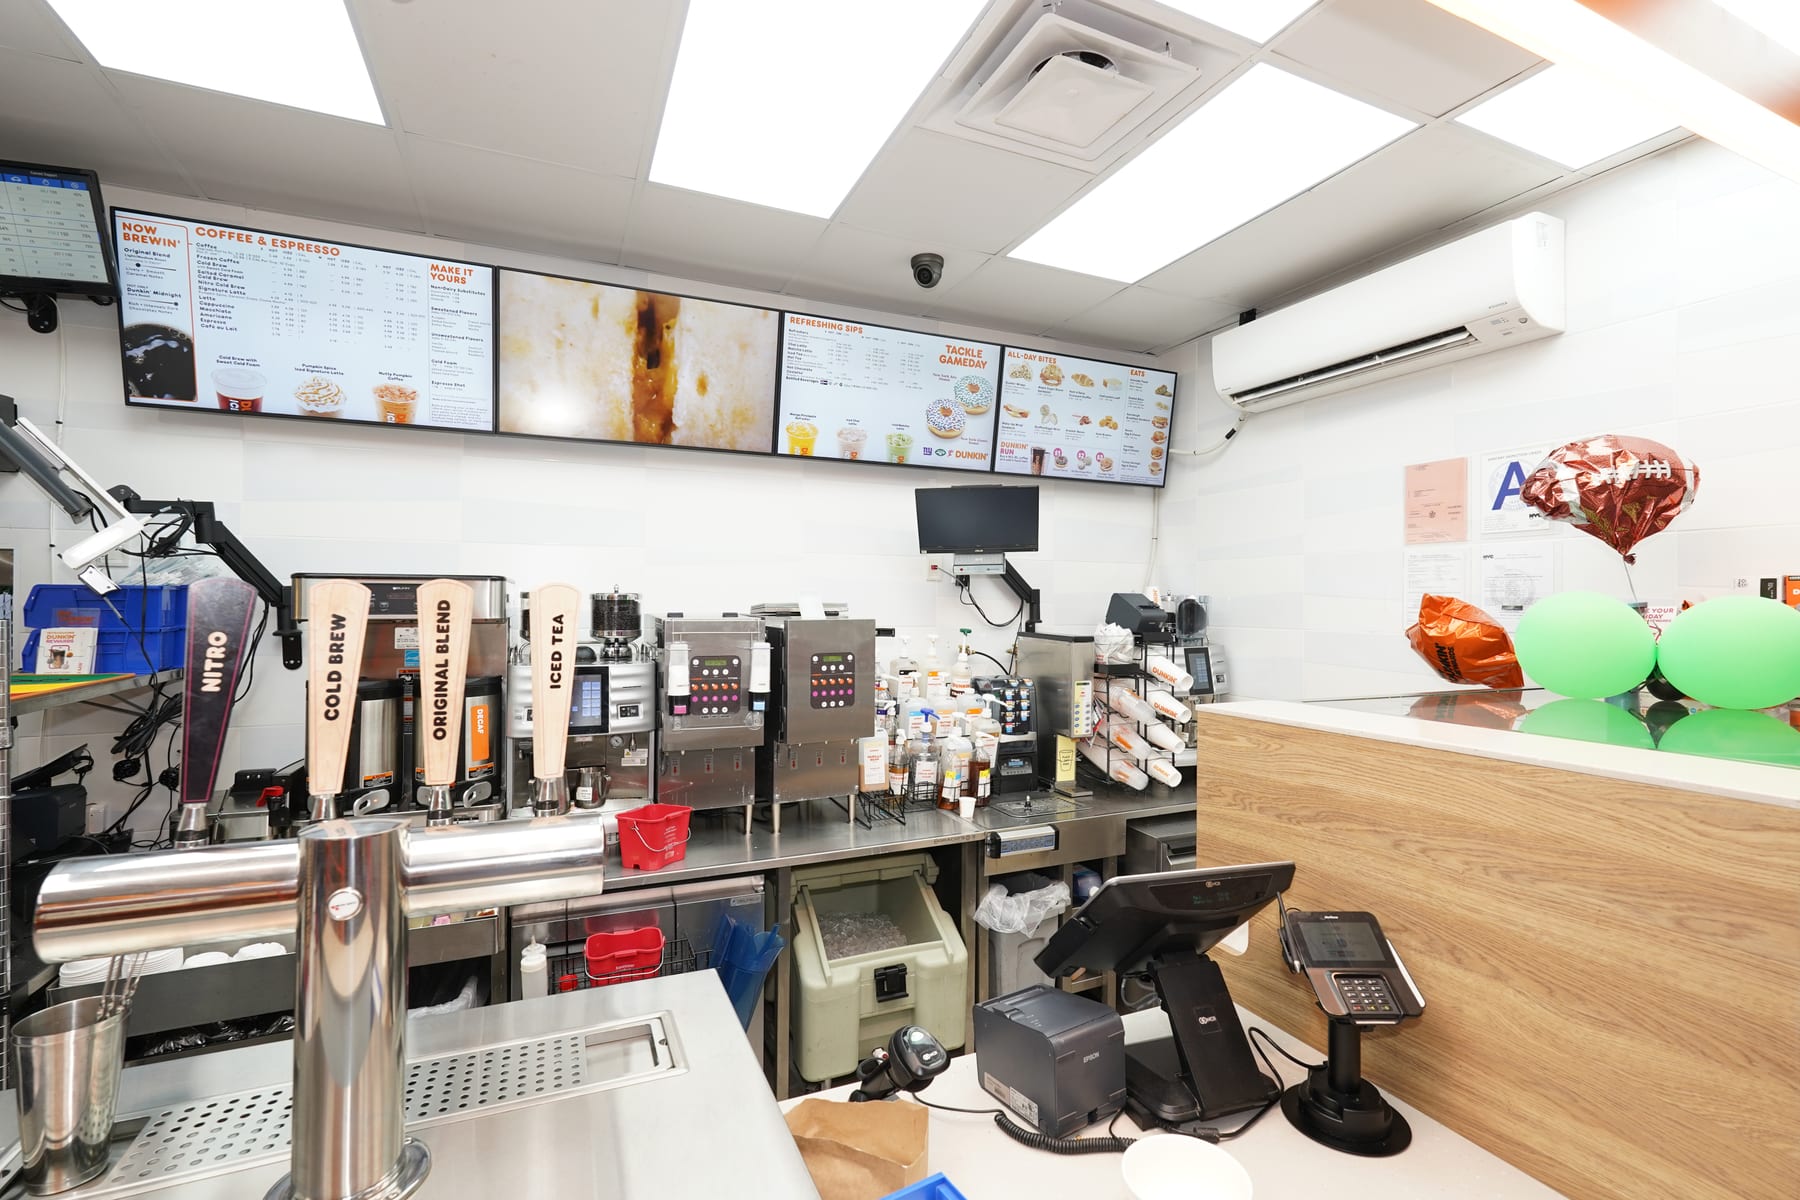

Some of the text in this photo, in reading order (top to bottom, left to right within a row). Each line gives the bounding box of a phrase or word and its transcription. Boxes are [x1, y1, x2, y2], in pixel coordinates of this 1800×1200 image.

[122, 222, 157, 235] NOW
[123, 232, 181, 248] BREWIN'
[195, 227, 340, 257] COFFEE & ESPRESSO
[430, 263, 474, 277] MAKE IT
[430, 272, 467, 284] YOURS
[789, 316, 864, 335] REFRESHING SIPS
[945, 344, 983, 359] TACKLE
[1007, 351, 1057, 365] ALL-DAY BITES
[939, 354, 988, 369] GAMEDAY
[1130, 369, 1145, 377] EATS
[1000, 441, 1029, 450] DUNKIN'
[1000, 447, 1015, 456] RUN
[955, 449, 988, 460] DUNKIN'
[1491, 460, 1536, 511] A
[549, 613, 564, 689] ICED TEA
[200, 631, 228, 692] NITRO
[324, 613, 347, 721] COLD BREW
[433, 599, 451, 741] ORIGINAL BLEND
[476, 707, 485, 735] DECAF
[1083, 1051, 1100, 1064] EPSON
